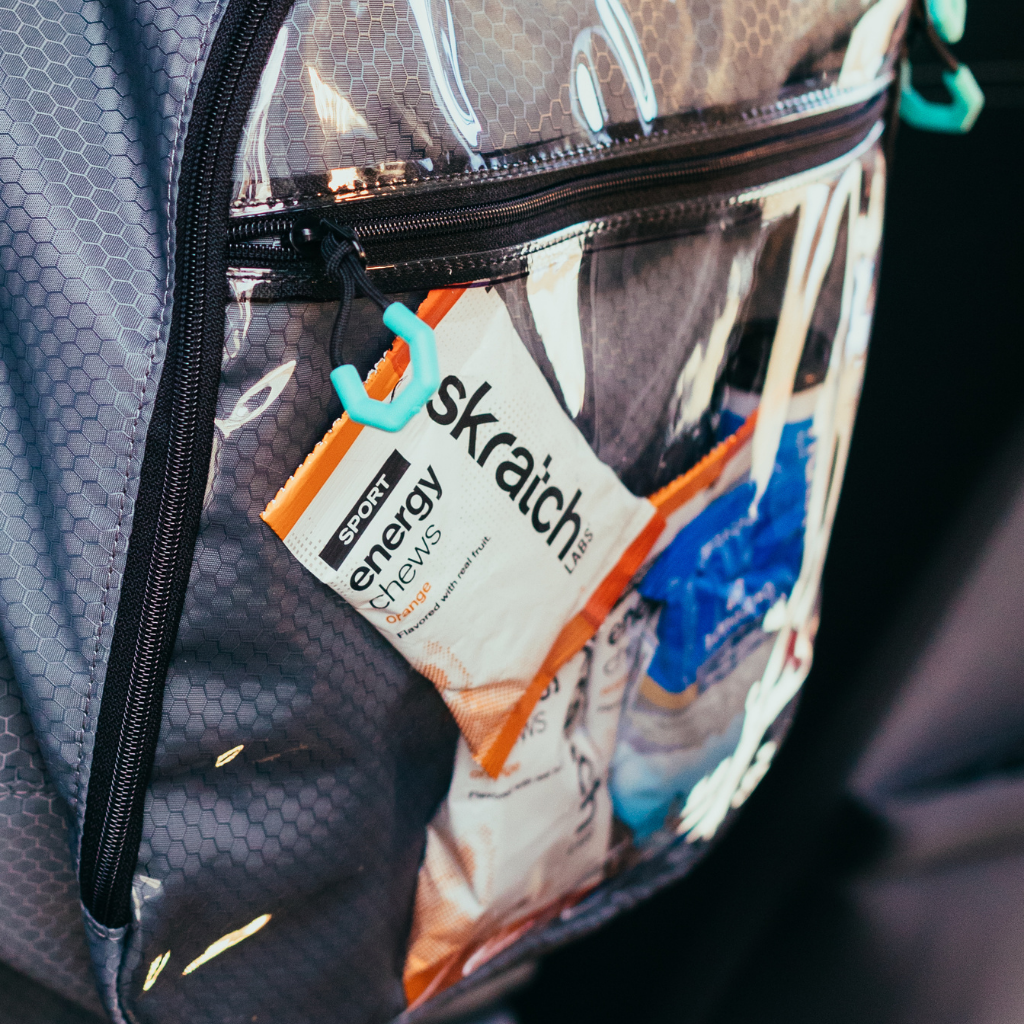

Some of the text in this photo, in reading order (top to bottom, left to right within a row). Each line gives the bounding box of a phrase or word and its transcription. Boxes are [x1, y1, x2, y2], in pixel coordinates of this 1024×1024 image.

[338, 473, 390, 546] SPORT
[426, 375, 582, 562] skratch
[349, 465, 443, 591] energy
[369, 524, 442, 610] chews
[564, 529, 594, 574] LABS
[386, 582, 432, 624] Orange
[396, 602, 441, 639] Flavored
[441, 580, 459, 602] with
[457, 557, 473, 580] real
